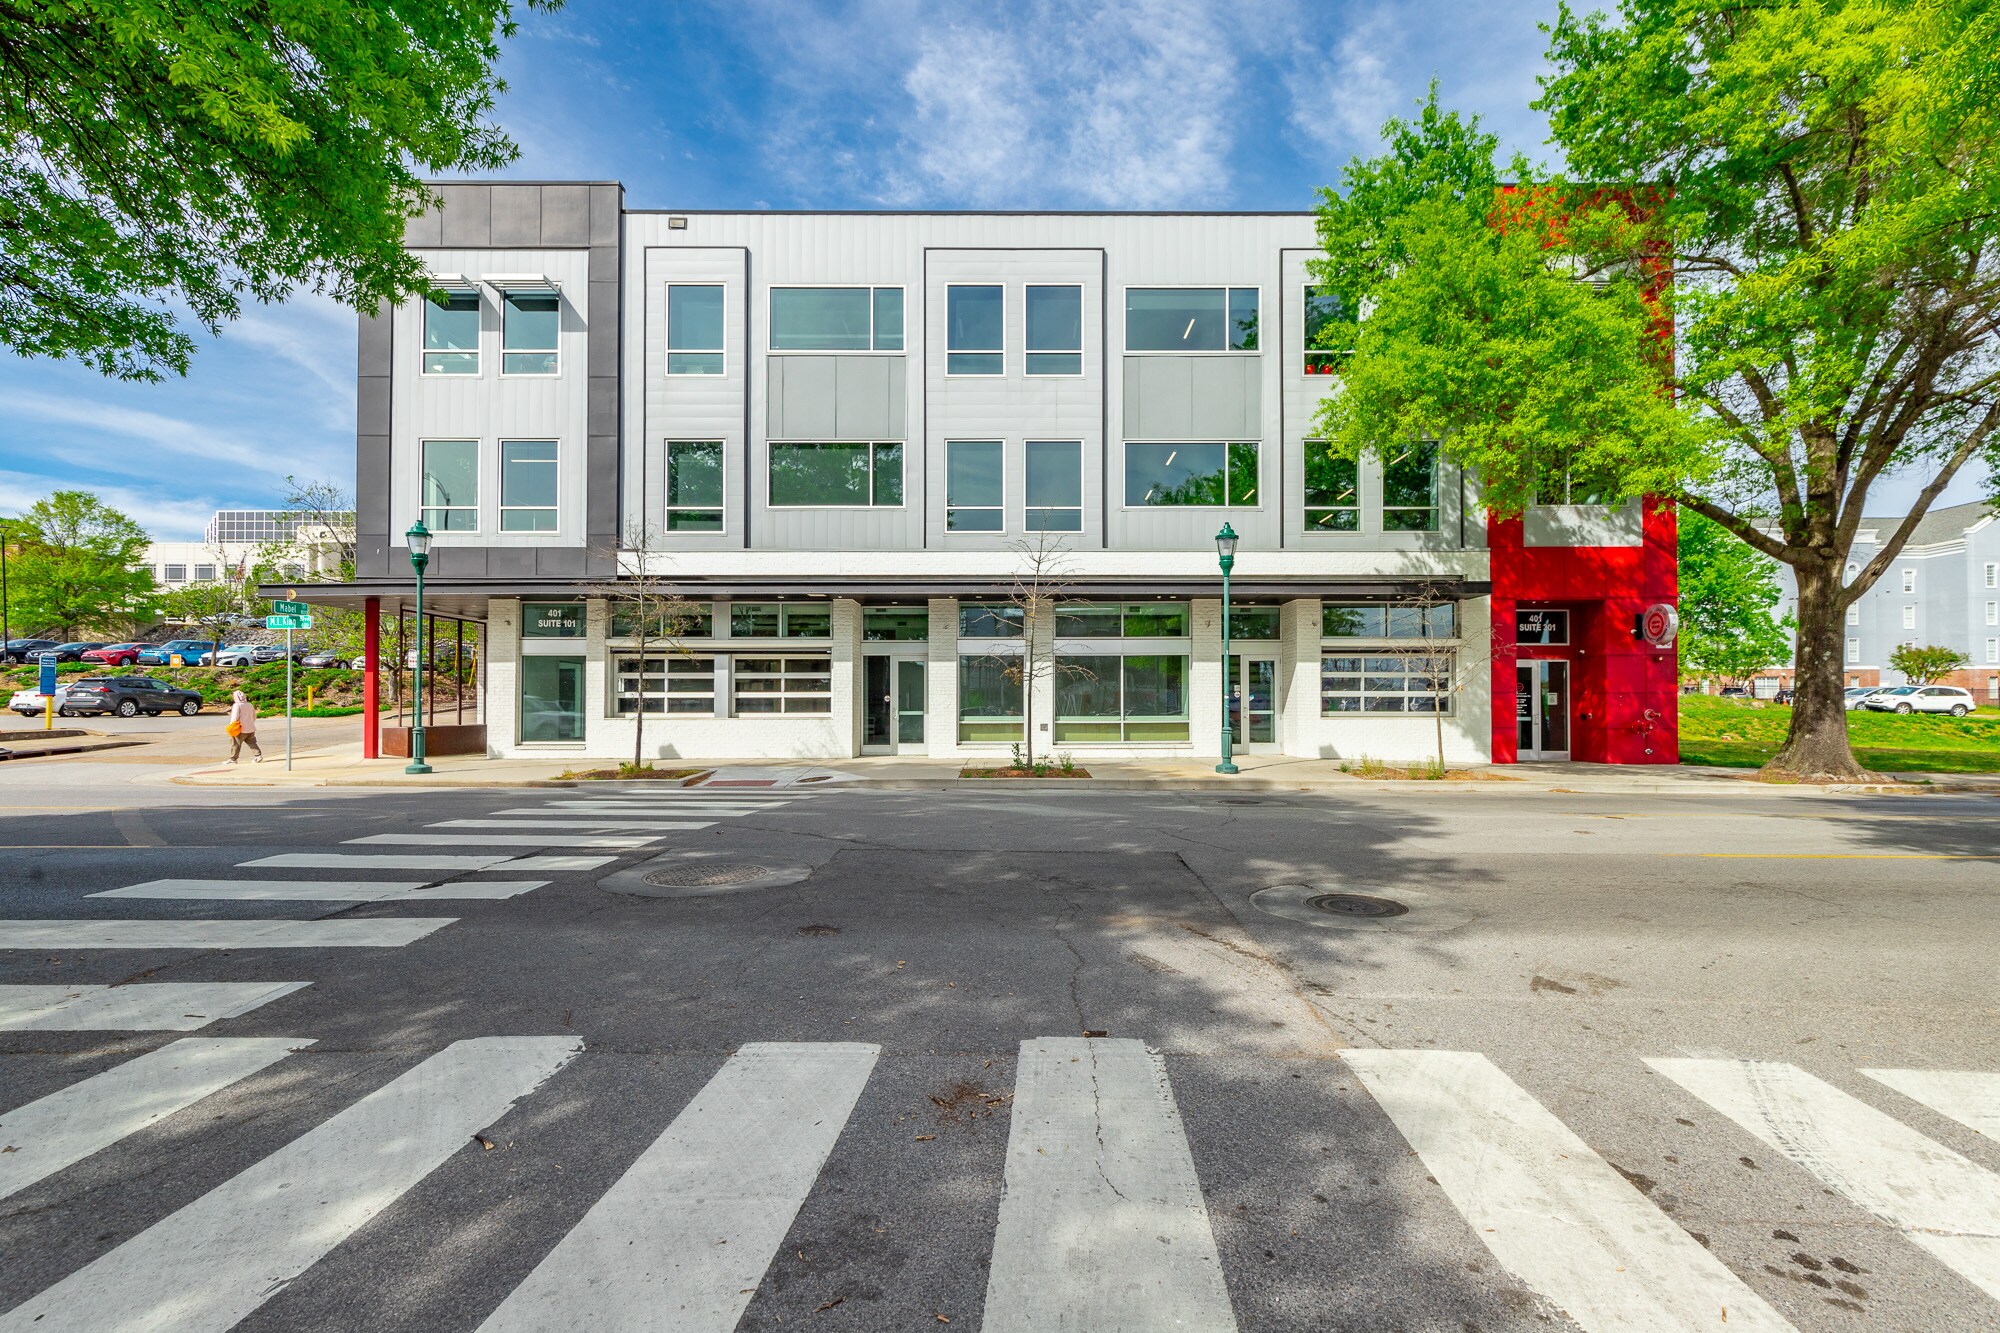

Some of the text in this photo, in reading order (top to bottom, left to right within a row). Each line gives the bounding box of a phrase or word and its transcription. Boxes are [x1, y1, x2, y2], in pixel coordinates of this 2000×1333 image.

[280, 603, 296, 613] Mabel
[548, 609, 561, 617] 401
[1529, 614, 1542, 622] 401
[1519, 623, 1541, 631] SUITE
